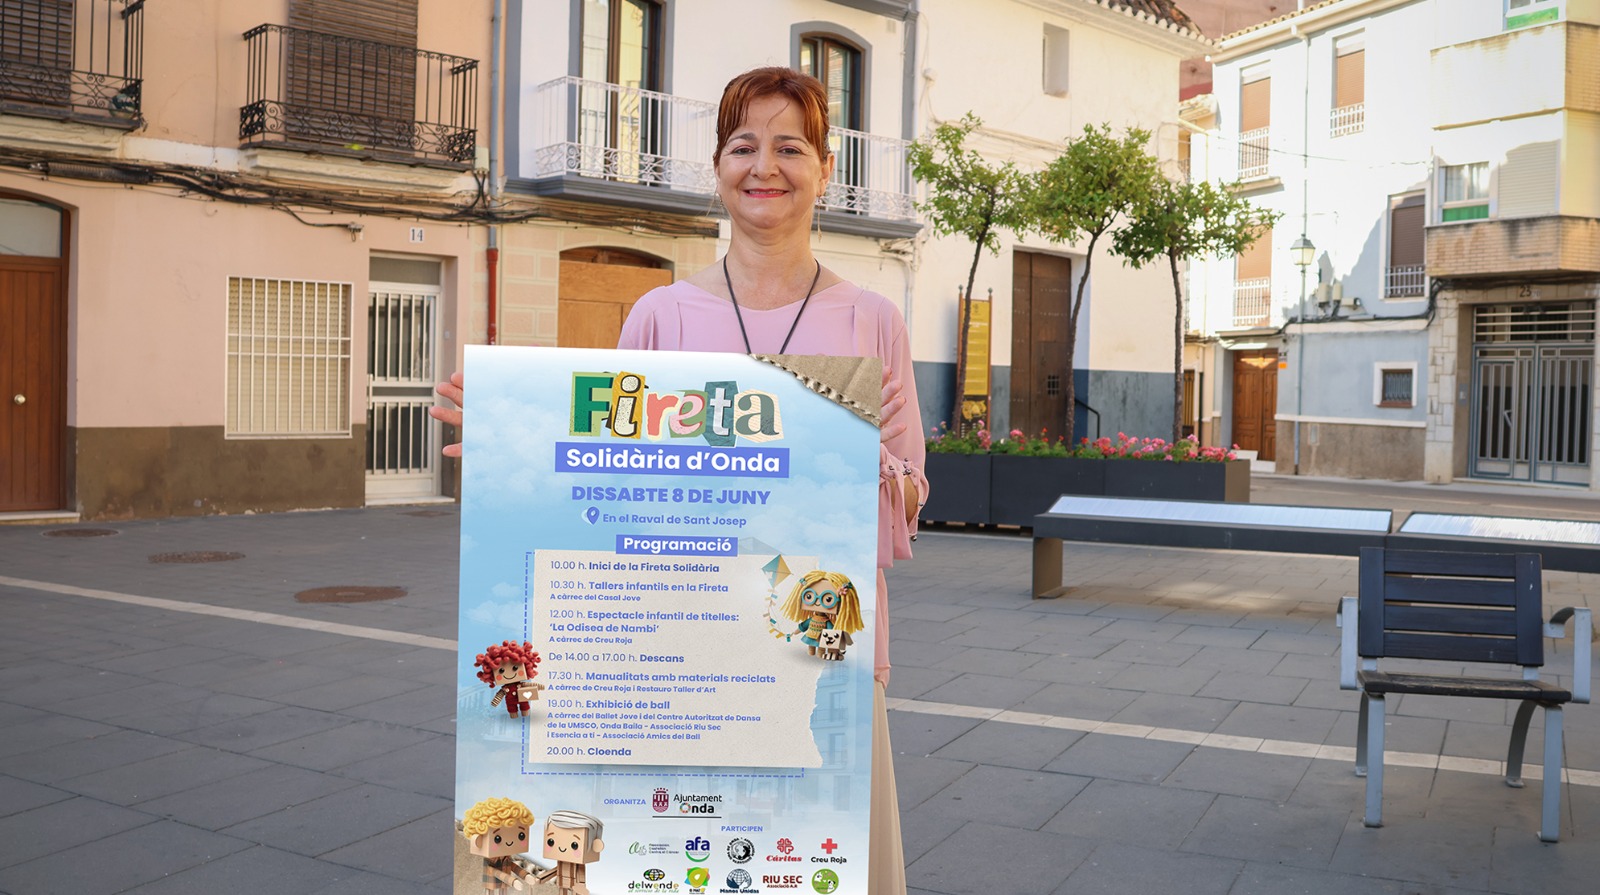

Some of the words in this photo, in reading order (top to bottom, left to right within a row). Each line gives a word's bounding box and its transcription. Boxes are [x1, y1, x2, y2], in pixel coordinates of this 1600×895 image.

[412, 228, 423, 241] 14
[574, 374, 780, 438] Fireta
[566, 448, 680, 470] Solidària
[571, 486, 668, 503] DISSABTE
[672, 488, 684, 503] 8
[688, 489, 712, 504] DE
[716, 490, 771, 505] JUNY
[603, 514, 617, 523] En
[619, 514, 629, 524] el
[632, 514, 664, 524] Raval
[667, 515, 681, 525] de
[684, 515, 710, 525] Sant
[713, 516, 747, 528] Josep
[623, 537, 731, 554] Programació
[551, 561, 575, 570] 10.00
[578, 561, 586, 570] h.
[589, 562, 611, 571] Inici
[614, 562, 626, 571] de
[628, 563, 638, 571] la
[641, 563, 671, 572] Fireta
[673, 563, 719, 572] Solidària
[550, 581, 574, 589] 10.30
[577, 581, 586, 590] h.
[589, 581, 624, 590] Tallers
[626, 582, 669, 591] infantils
[686, 583, 696, 592] la
[699, 583, 728, 592] Fireta
[550, 610, 574, 618] 12.00
[576, 610, 585, 618] h.
[588, 610, 645, 621] Espectacle
[646, 611, 683, 620] infantil
[686, 612, 699, 621] de
[701, 612, 739, 621] titelles:
[567, 624, 606, 632] Odisea
[608, 624, 619, 632] de
[549, 653, 562, 661] De
[565, 653, 590, 661] 14.00
[602, 653, 626, 662] 17.00
[628, 654, 637, 662] h.
[640, 654, 685, 663] Descans
[548, 672, 572, 680] 17.30
[574, 672, 583, 680] h.
[586, 672, 649, 682] Manualitats
[652, 673, 676, 682] amb
[678, 673, 729, 683] materials
[731, 674, 776, 683] reciclats
[548, 699, 572, 708] 19.00
[575, 699, 584, 708] h.
[586, 699, 633, 709] Exhibició
[635, 700, 648, 709] de
[650, 701, 670, 709] ball
[547, 747, 574, 755] 20.00
[576, 747, 585, 755] h.
[588, 747, 631, 756] Cloenda
[673, 794, 722, 803] Ajuntament
[680, 803, 714, 814] Onda
[685, 837, 710, 851] afa
[628, 881, 679, 889] delwende
[763, 875, 782, 884] RIU
[783, 875, 802, 884] SEC
